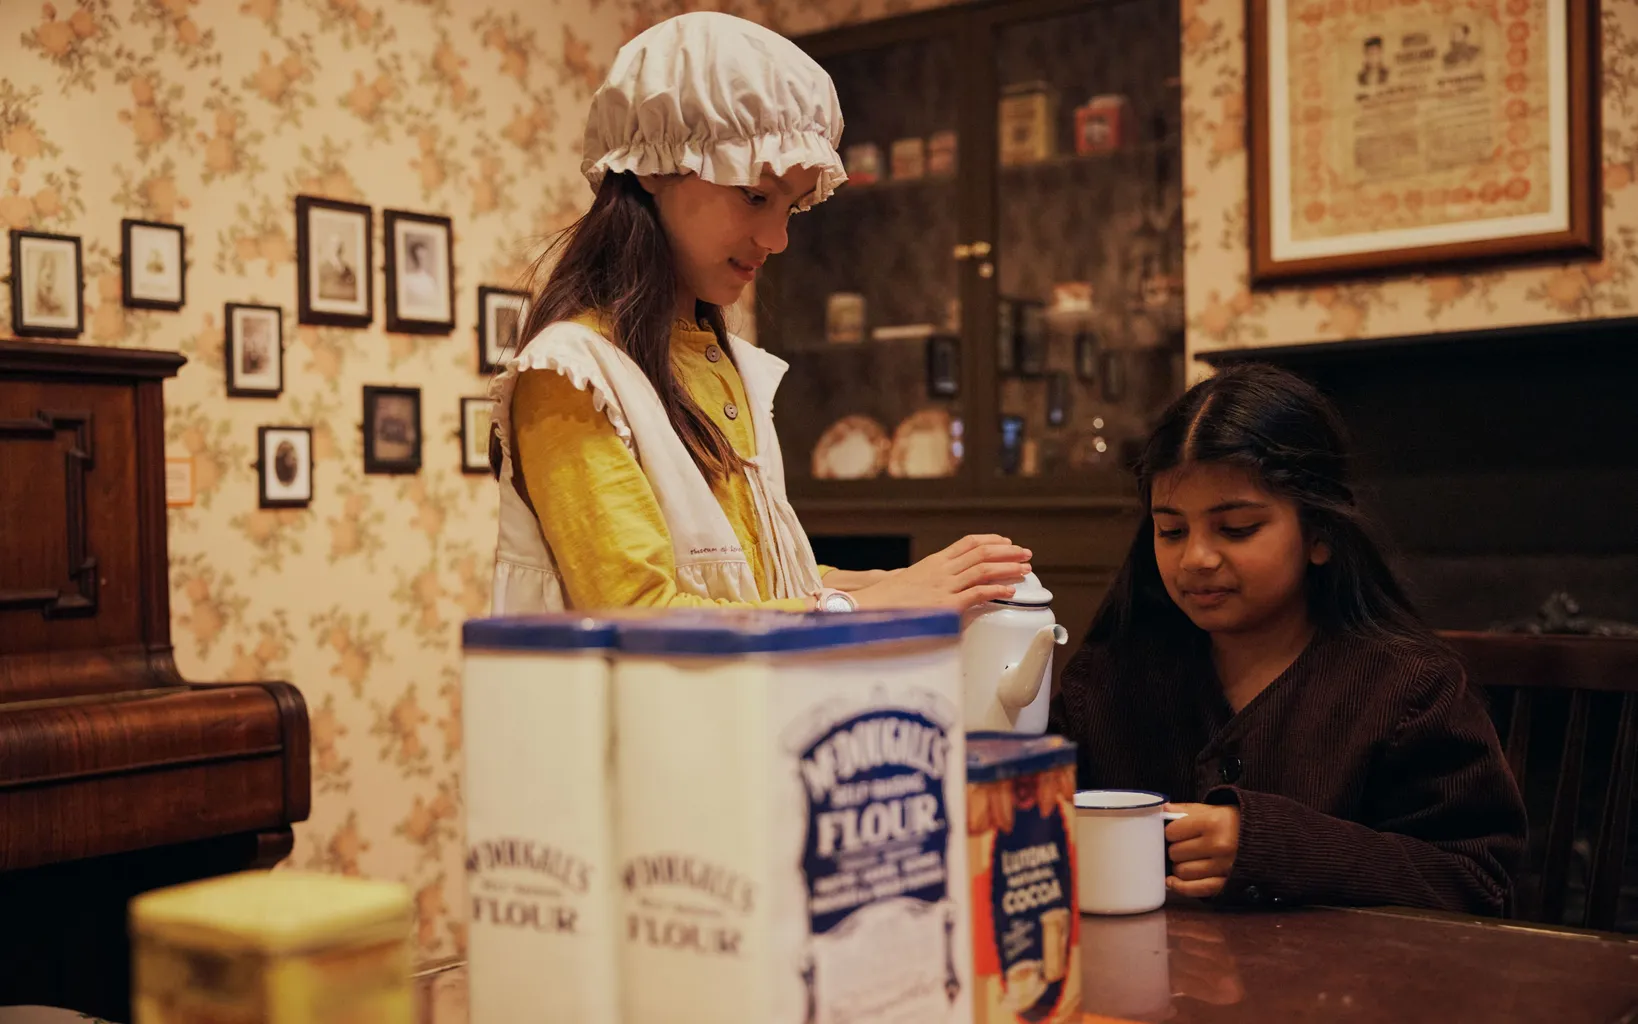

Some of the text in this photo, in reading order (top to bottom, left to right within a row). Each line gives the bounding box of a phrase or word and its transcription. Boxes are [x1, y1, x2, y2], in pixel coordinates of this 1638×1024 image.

[689, 546, 718, 555] Museum
[720, 545, 729, 555] of
[472, 896, 579, 934] FLOUR
[1001, 879, 1063, 915] COCOA
[627, 913, 746, 955] FLOUR
